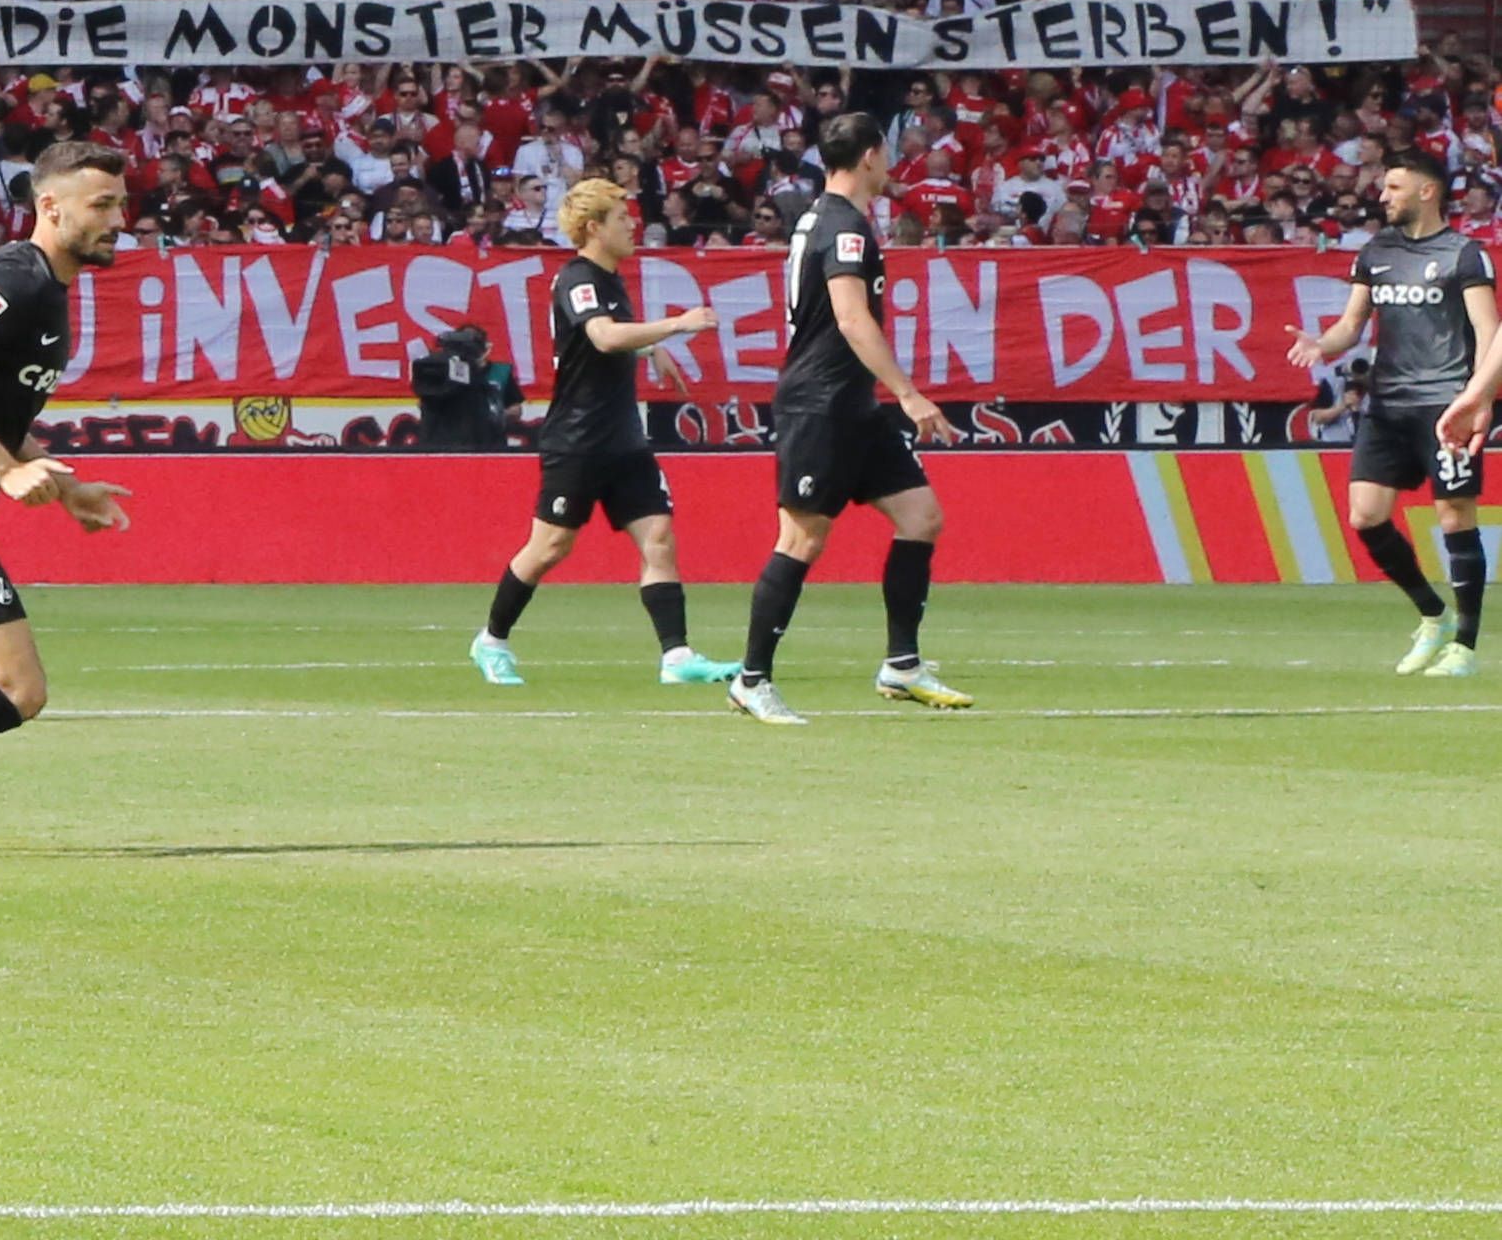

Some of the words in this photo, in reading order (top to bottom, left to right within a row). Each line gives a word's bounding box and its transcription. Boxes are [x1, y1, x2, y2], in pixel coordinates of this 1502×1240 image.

[163, 2, 549, 59] MONSTER
[579, 0, 900, 64] MÜSSEN
[1038, 259, 1257, 388] DER
[1436, 448, 1473, 482] 32
